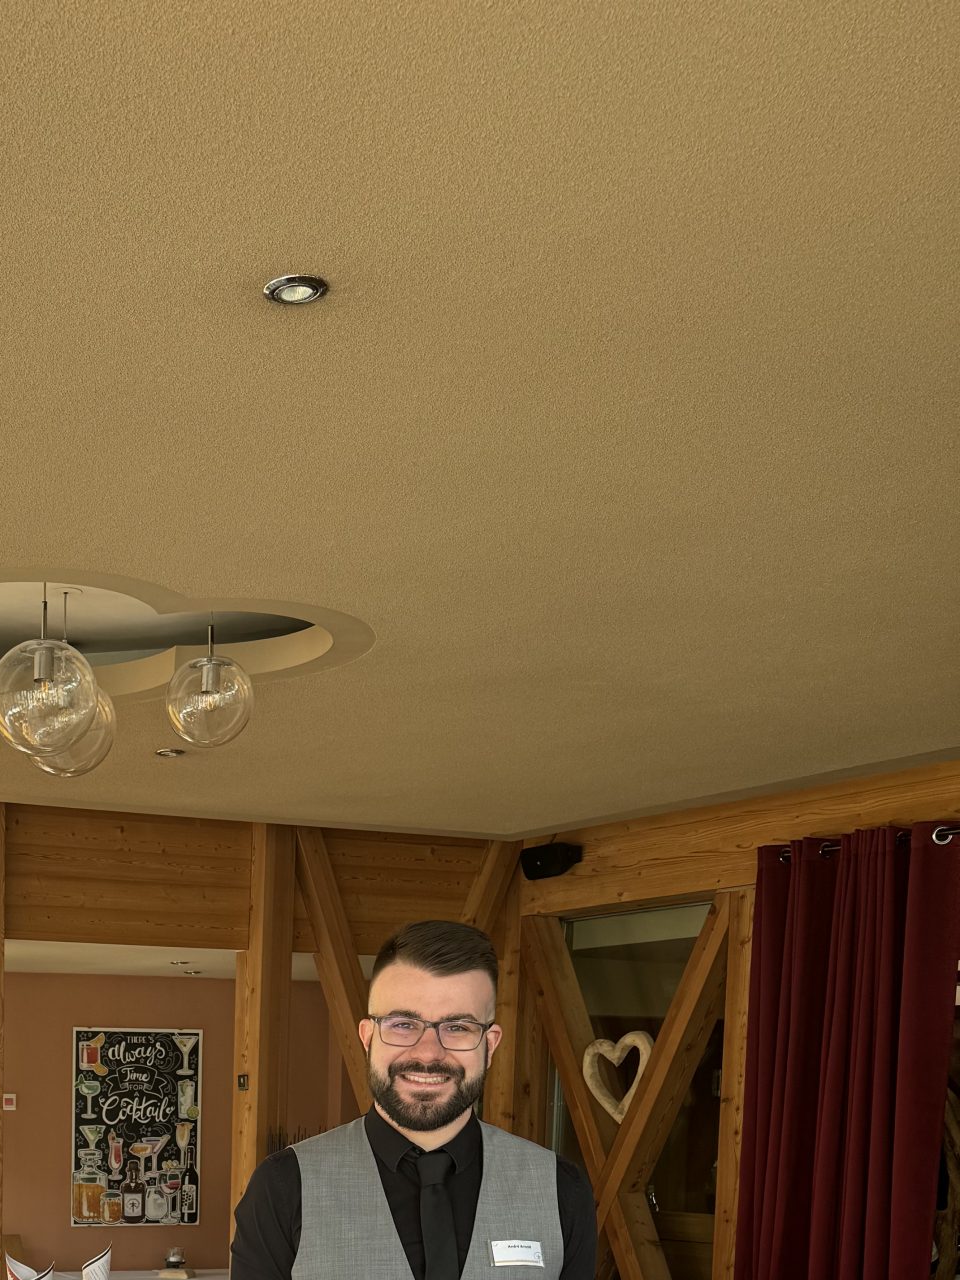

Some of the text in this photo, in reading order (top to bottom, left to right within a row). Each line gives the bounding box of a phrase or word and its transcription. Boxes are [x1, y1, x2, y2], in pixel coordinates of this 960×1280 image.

[127, 1036, 155, 1044] THERE'S
[108, 1041, 166, 1066] always
[121, 1067, 150, 1082] Time
[100, 1096, 175, 1125] Cocktail
